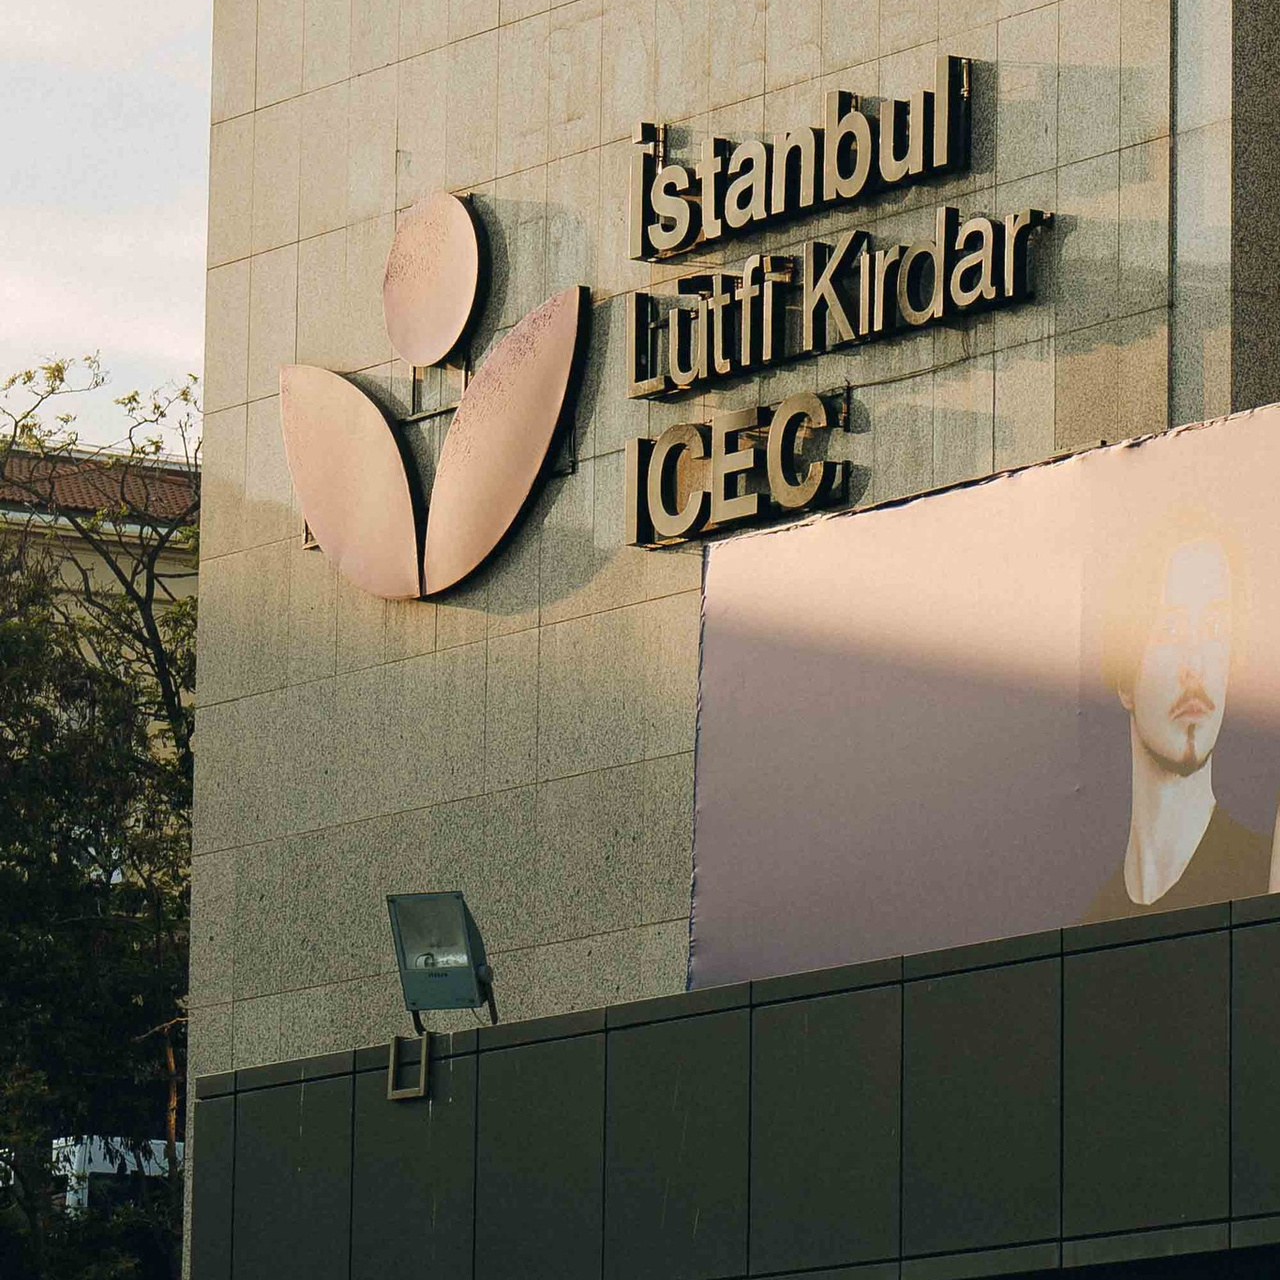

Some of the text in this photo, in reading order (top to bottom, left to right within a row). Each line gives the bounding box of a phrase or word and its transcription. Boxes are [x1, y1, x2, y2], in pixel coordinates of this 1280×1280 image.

[629, 55, 956, 261] İstanbul
[803, 206, 1038, 352] Kırdar
[626, 392, 828, 546] ICEC
